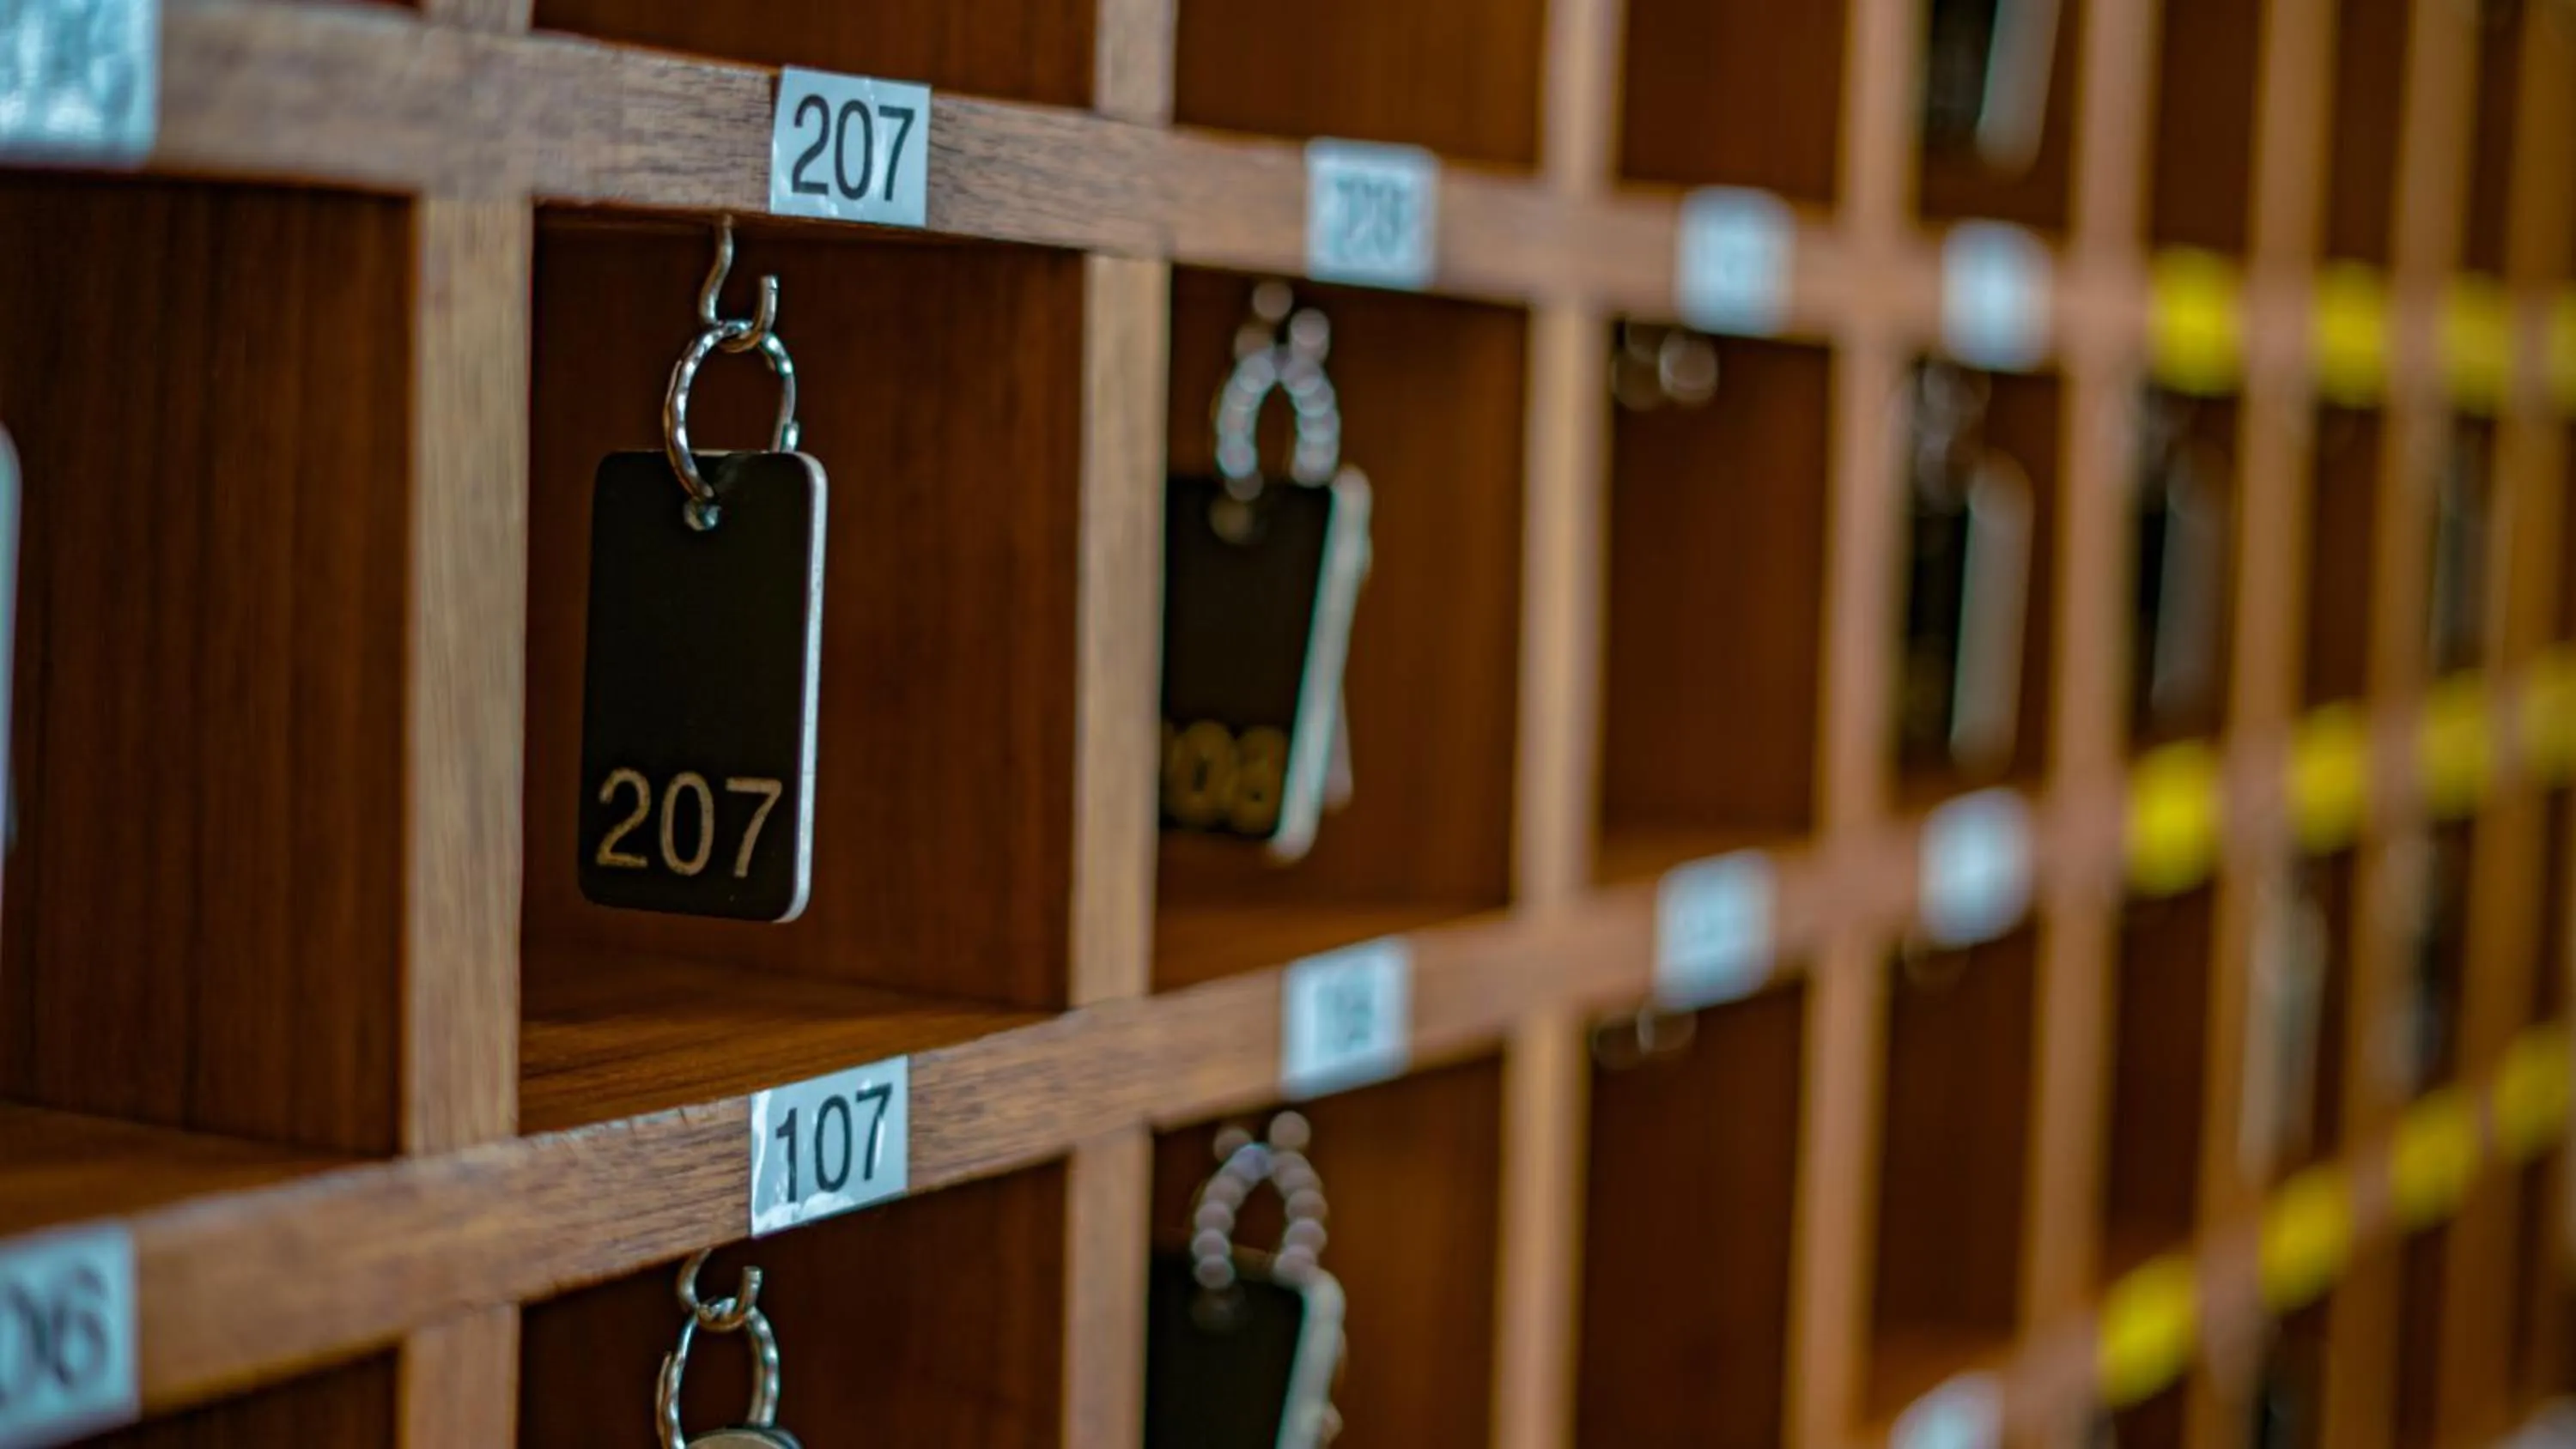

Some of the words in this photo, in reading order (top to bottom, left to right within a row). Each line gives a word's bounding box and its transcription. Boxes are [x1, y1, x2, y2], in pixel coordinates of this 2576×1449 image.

[792, 94, 914, 202] 207
[597, 768, 782, 877] 207
[775, 1082, 892, 1203] 107
